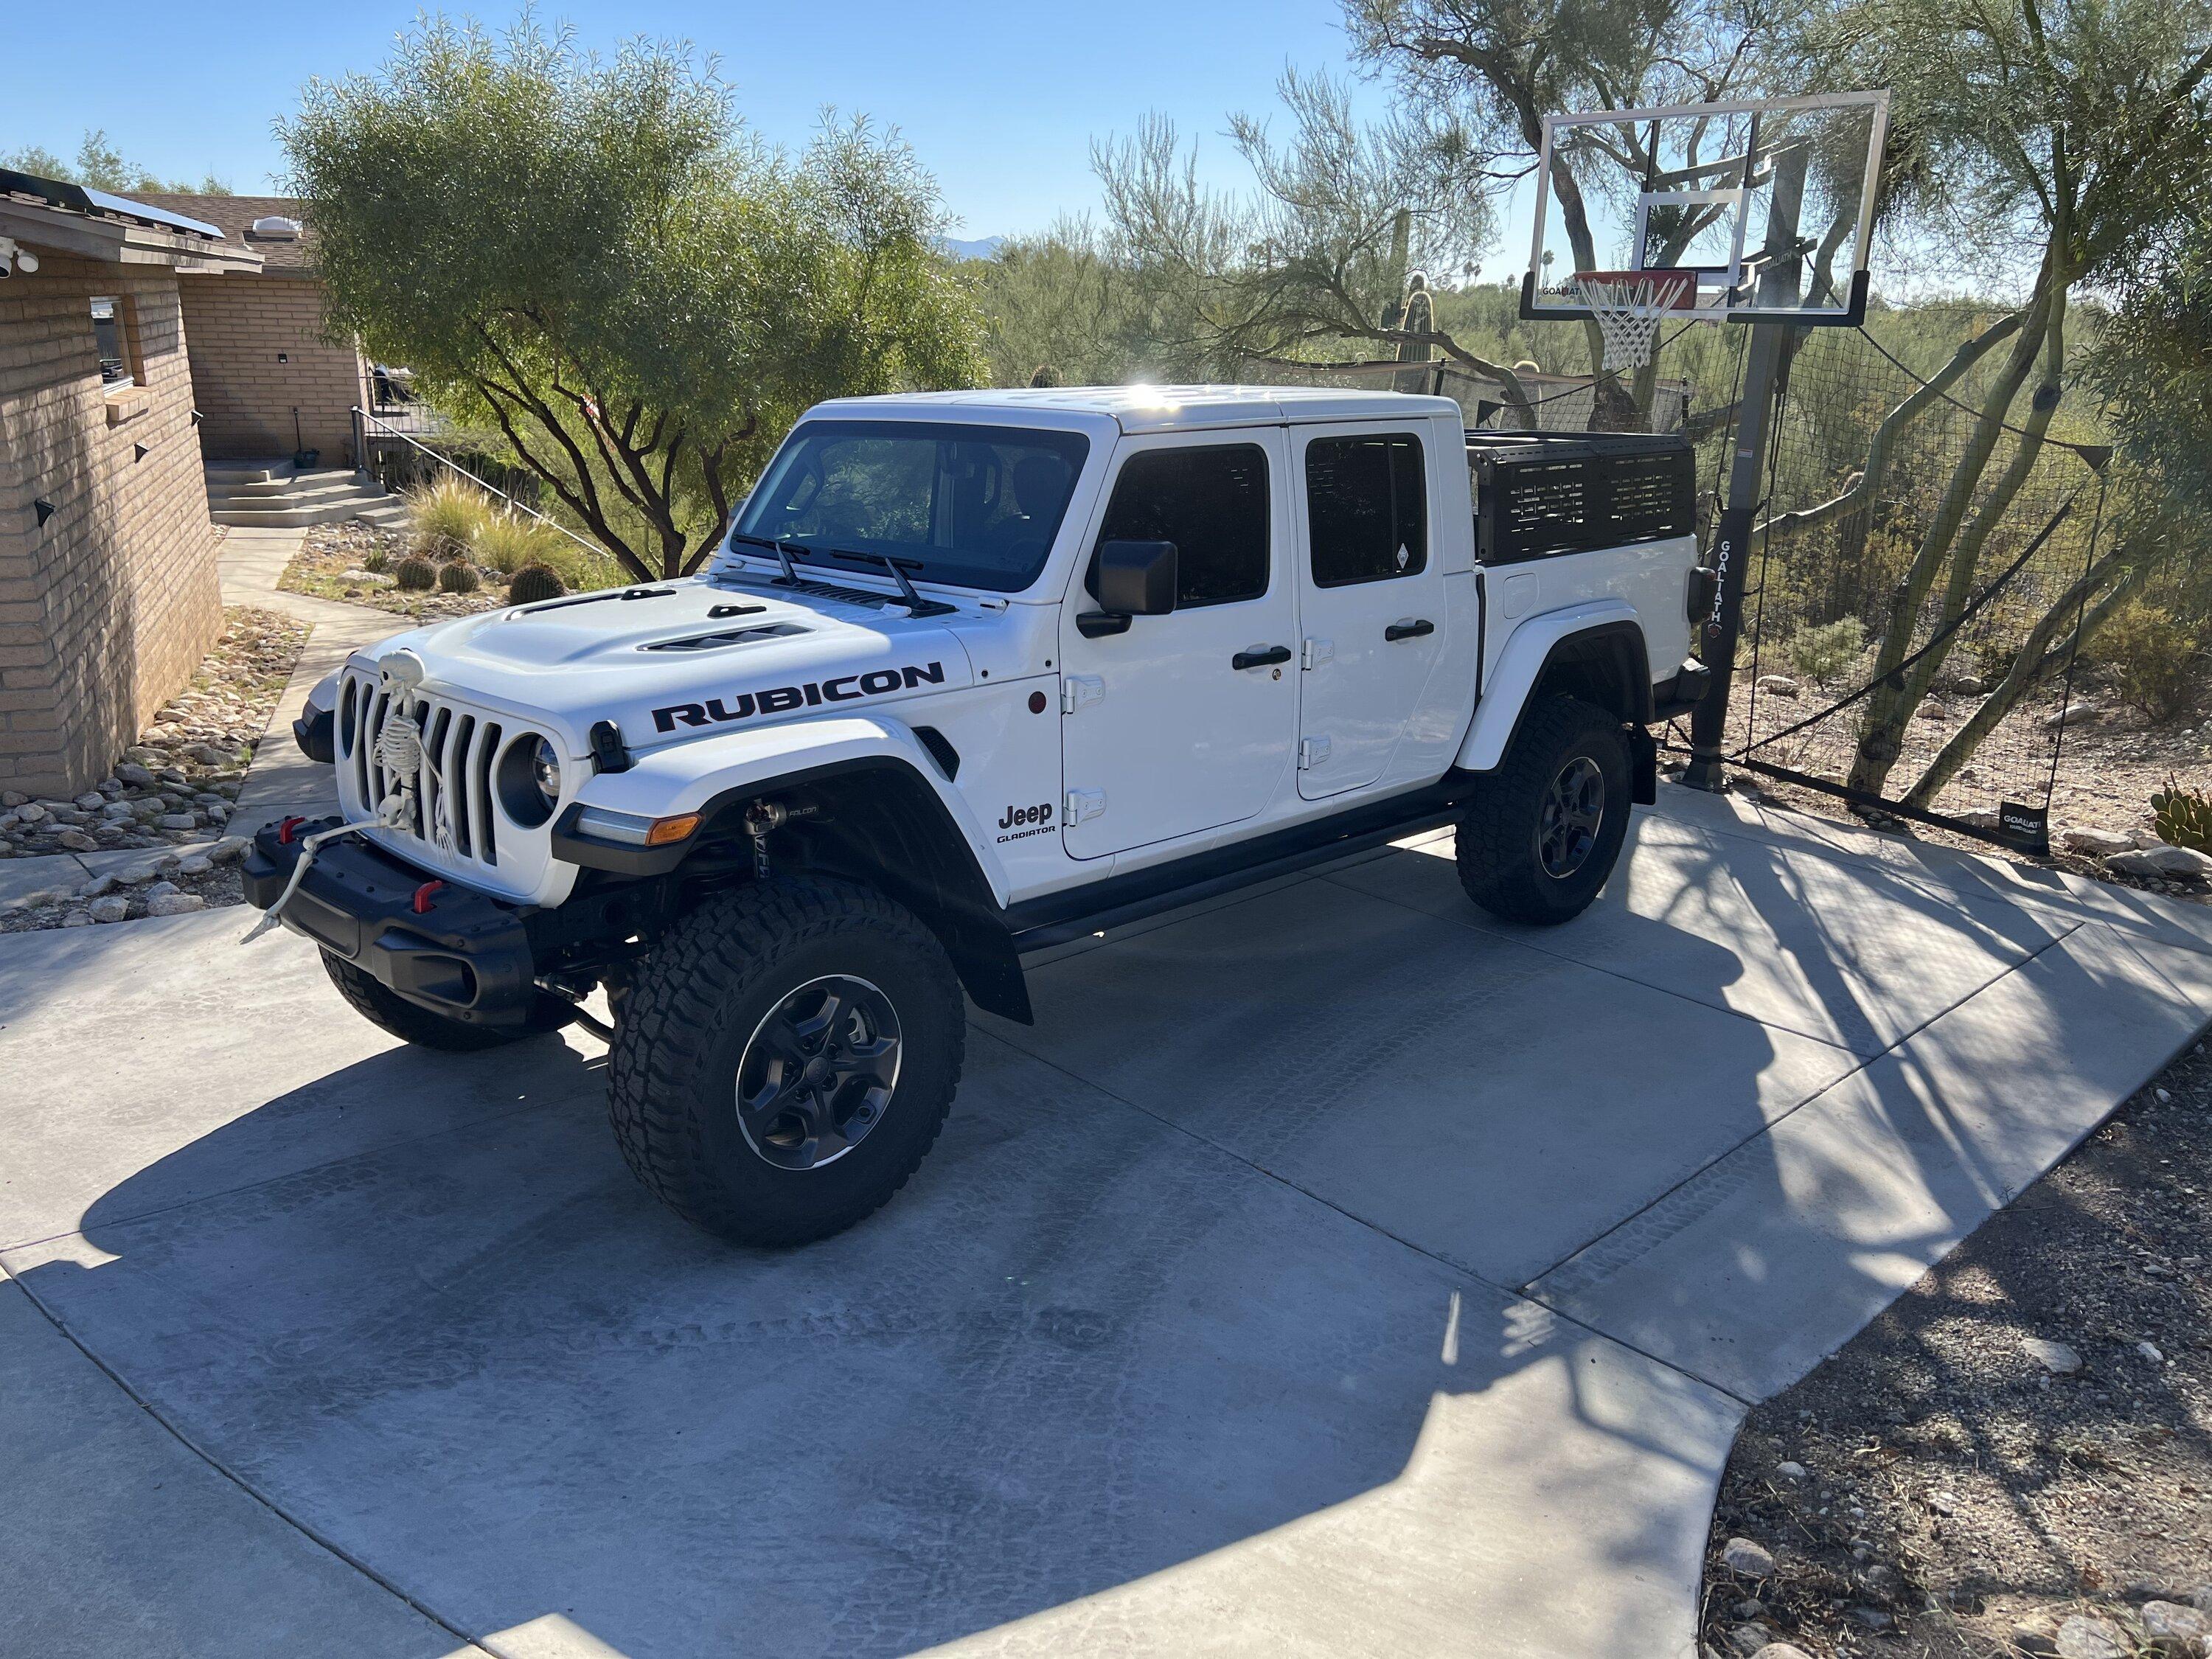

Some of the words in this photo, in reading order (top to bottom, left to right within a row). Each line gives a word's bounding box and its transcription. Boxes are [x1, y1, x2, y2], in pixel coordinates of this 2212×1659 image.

[1711, 540, 1731, 622] GOALIATH
[651, 661, 945, 734] RUBICON
[997, 826, 1056, 844] GLADIATOR
[998, 803, 1053, 830] Jeep
